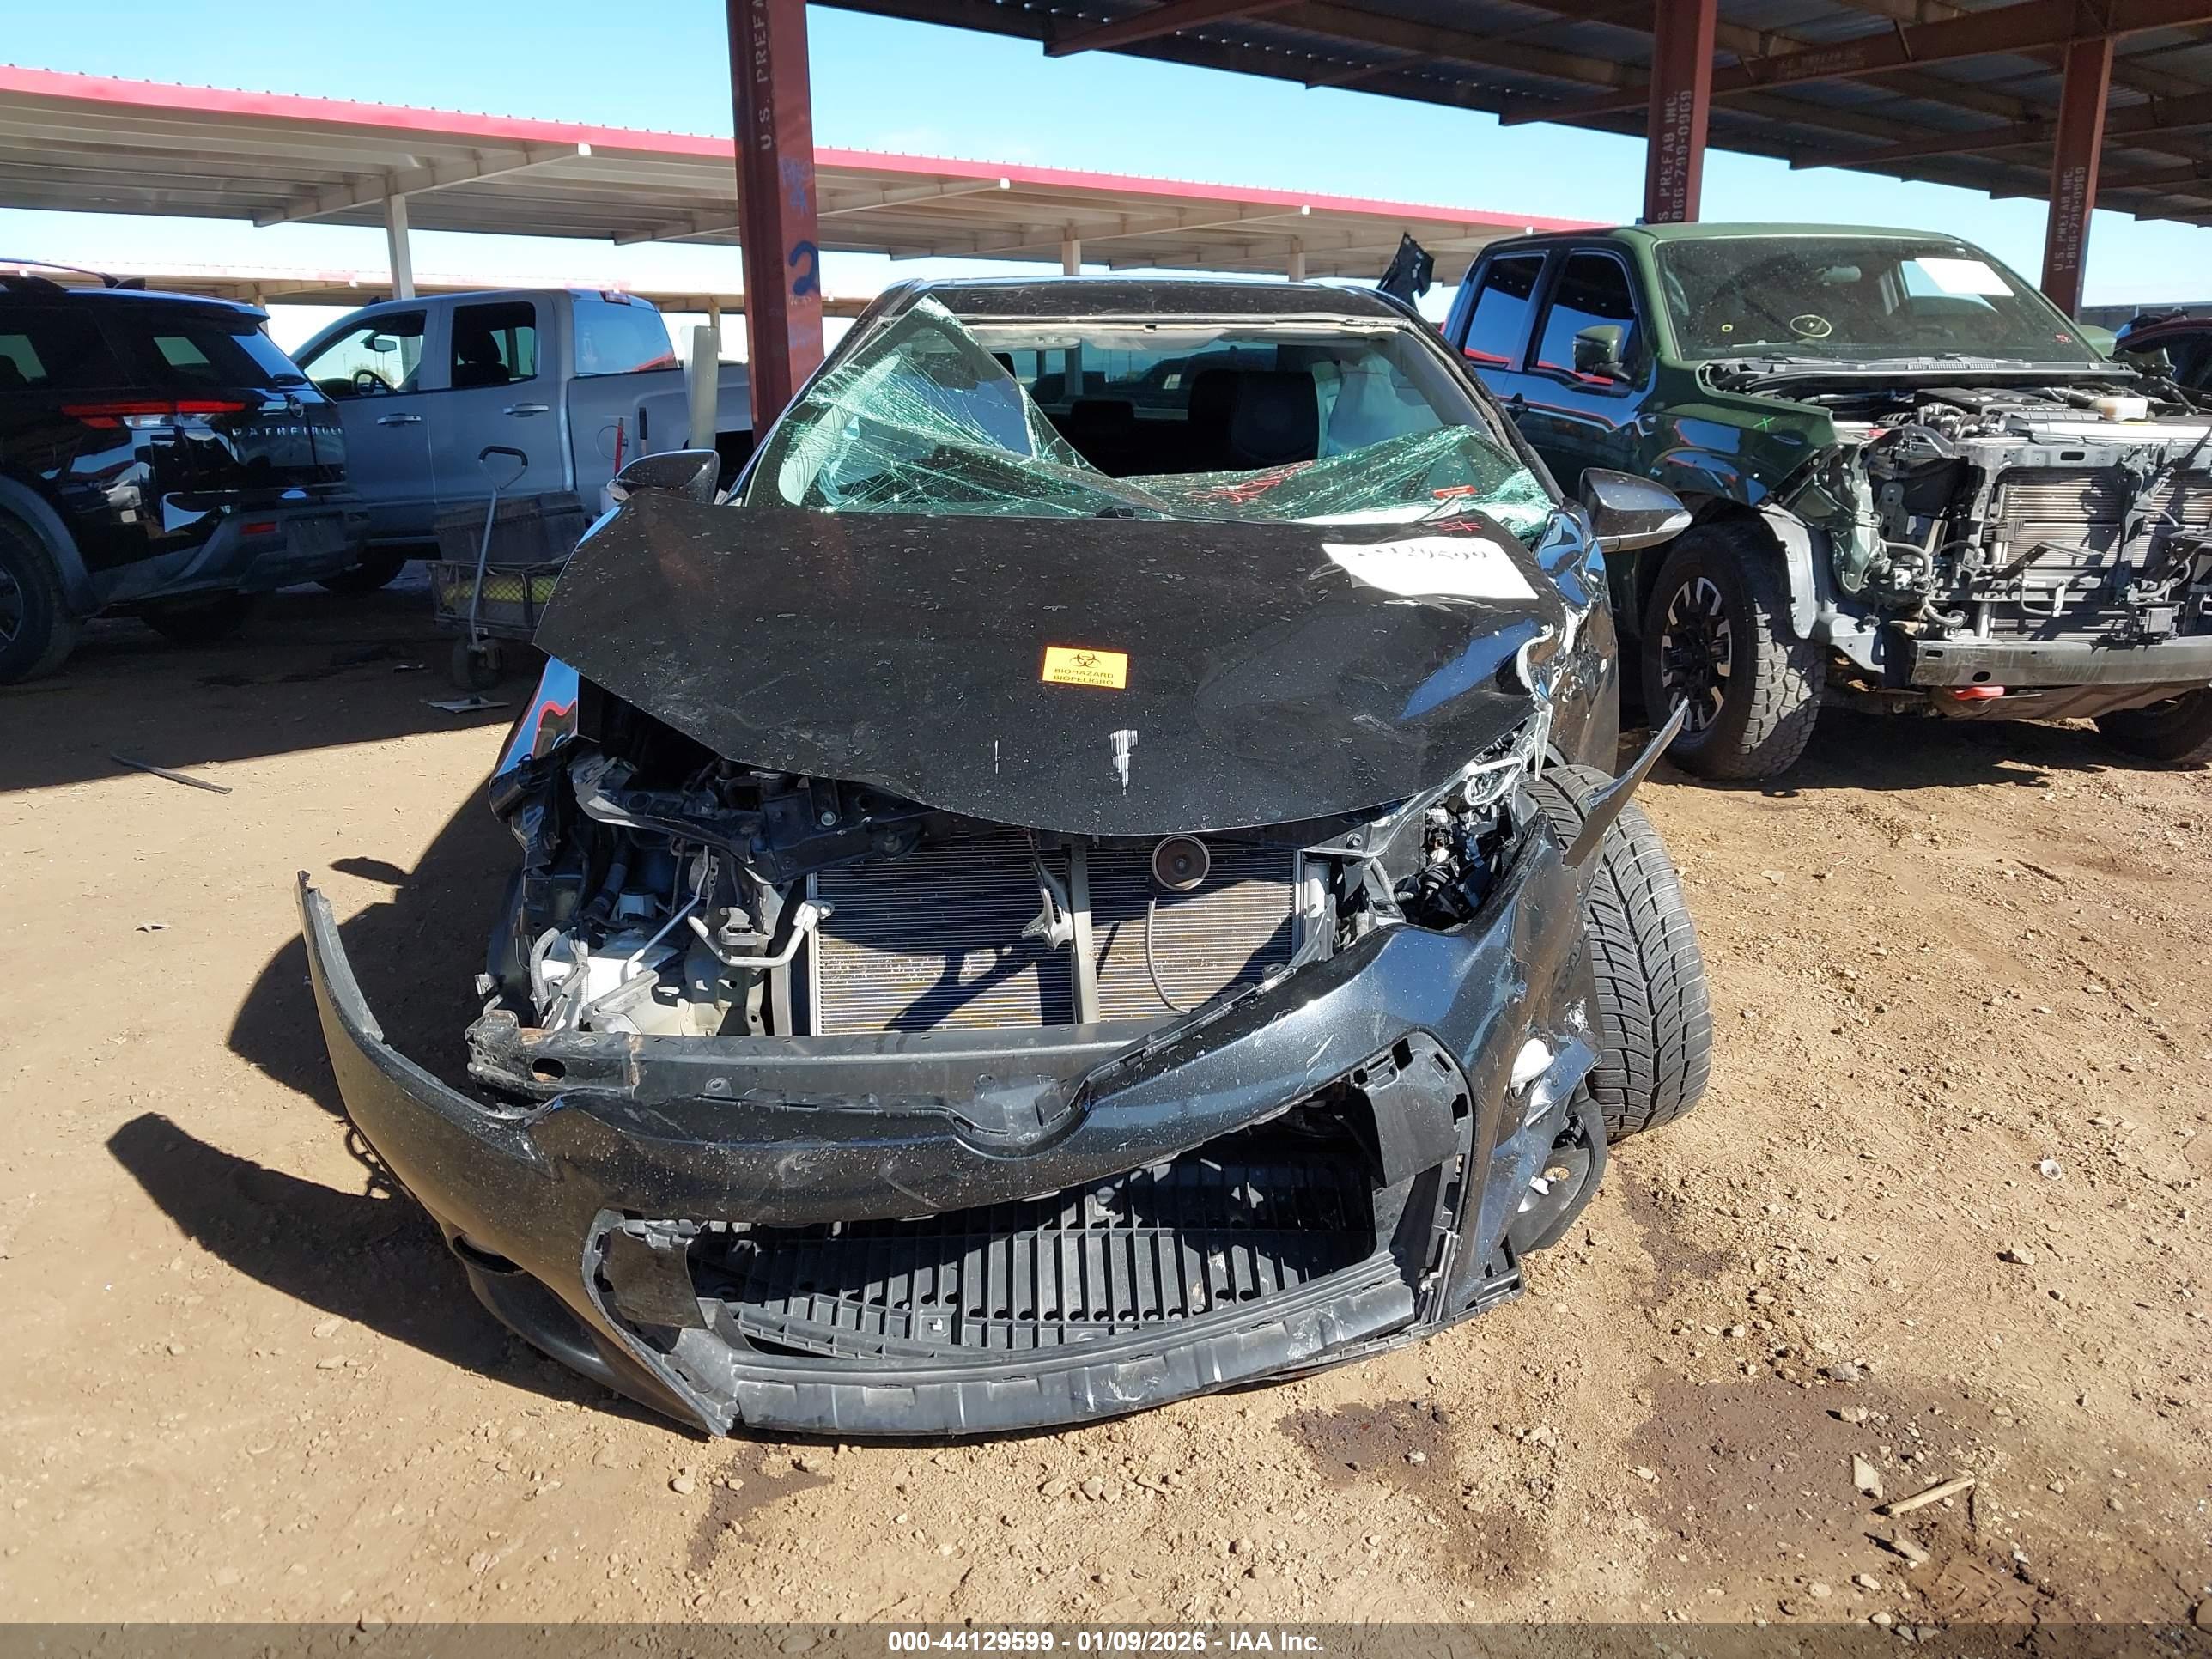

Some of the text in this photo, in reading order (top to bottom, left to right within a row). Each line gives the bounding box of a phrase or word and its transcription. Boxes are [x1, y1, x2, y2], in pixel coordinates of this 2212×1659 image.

[1660, 132, 1674, 197] PREFAB
[2057, 197, 2072, 242] PREFAB
[789, 240, 821, 295] 2
[1053, 675, 1114, 685] BIOPELIGRO
[1054, 668, 1114, 678] BIOHAZARD
